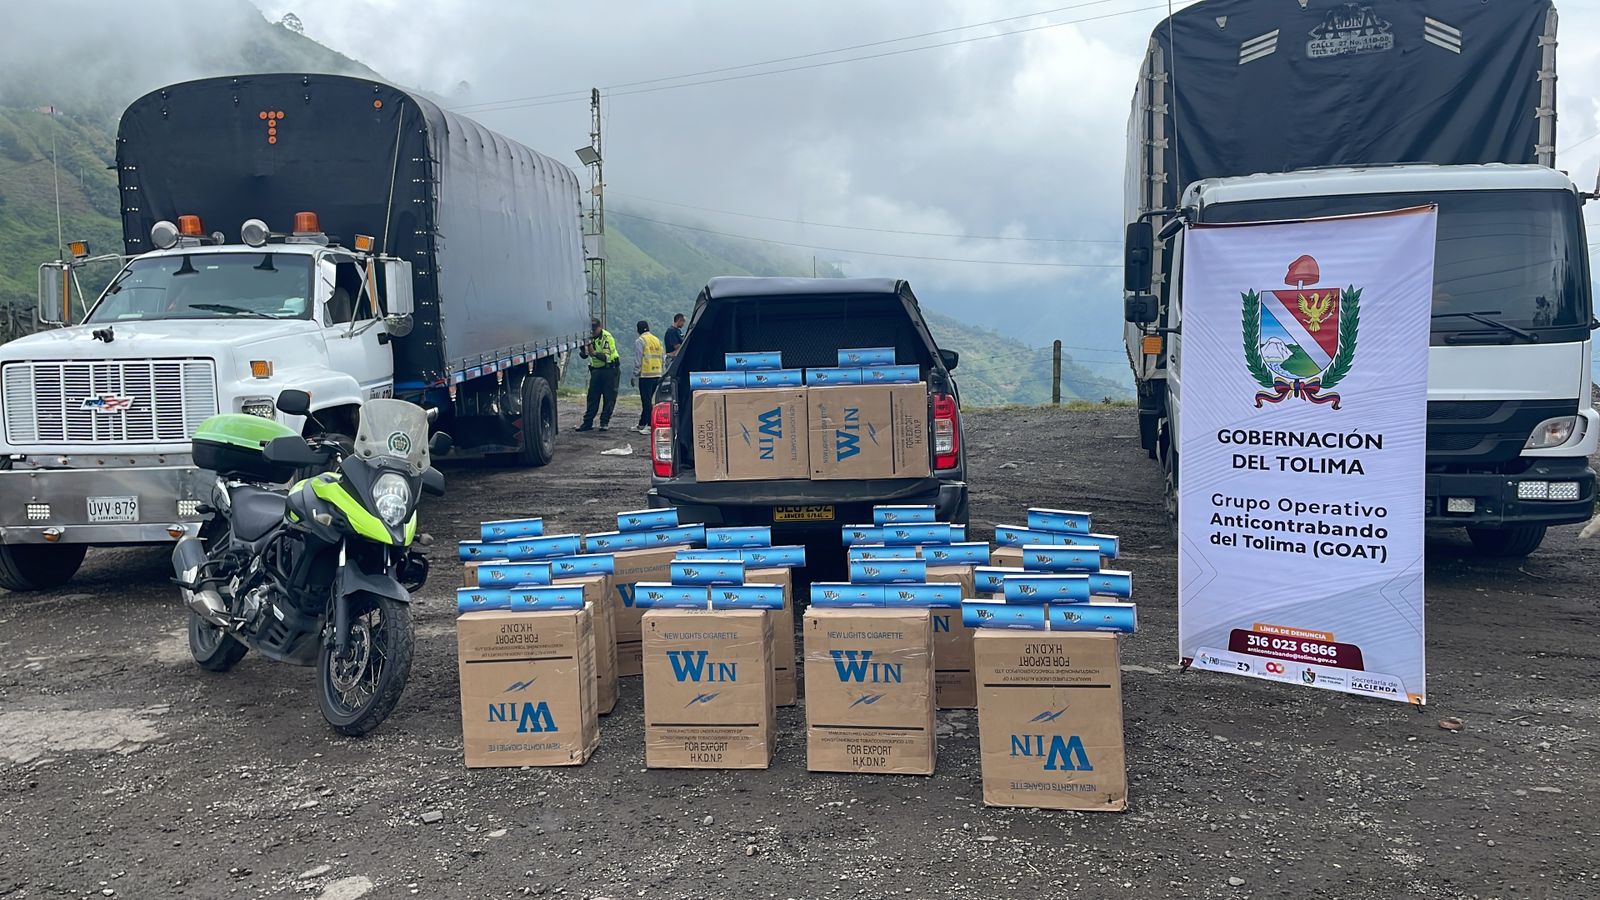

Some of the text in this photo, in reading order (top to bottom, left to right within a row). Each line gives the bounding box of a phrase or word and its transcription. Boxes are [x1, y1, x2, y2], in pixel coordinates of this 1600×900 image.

[758, 406, 782, 460] WIN
[836, 408, 861, 462] WIN
[1217, 428, 1383, 450] GOBERNACIÓN
[1232, 454, 1365, 476] DEL TOLIMA
[114, 501, 137, 515] 879
[1211, 493, 1388, 518] Grupo Operativo
[1210, 512, 1388, 539] Anticontrabando
[1210, 532, 1388, 564] del Tolima (GOAT)
[495, 634, 539, 645] FOR EXPORT
[664, 632, 738, 640] NEW LIGHTS CIGARETTE
[827, 631, 903, 640] NEW LIGHTS CIGARETTE
[1290, 630, 1327, 640] DENUNCIA
[1247, 634, 1337, 657] 316 023 6866
[1018, 656, 1070, 667] FOR EXPORT
[1247, 647, 1337, 664] anticontrabando@tolima.gov.co
[666, 650, 738, 682] WIN
[829, 650, 903, 683] WIN
[1351, 682, 1397, 693] HACIENDA
[1352, 675, 1386, 687] Secretaría
[488, 701, 559, 733] WIN
[684, 742, 728, 751] FOR EXPORT
[846, 745, 892, 755] FOR EXPORT
[1010, 735, 1094, 772] WIN
[1010, 781, 1097, 792] NEW LIGHTS CIGARETTE
